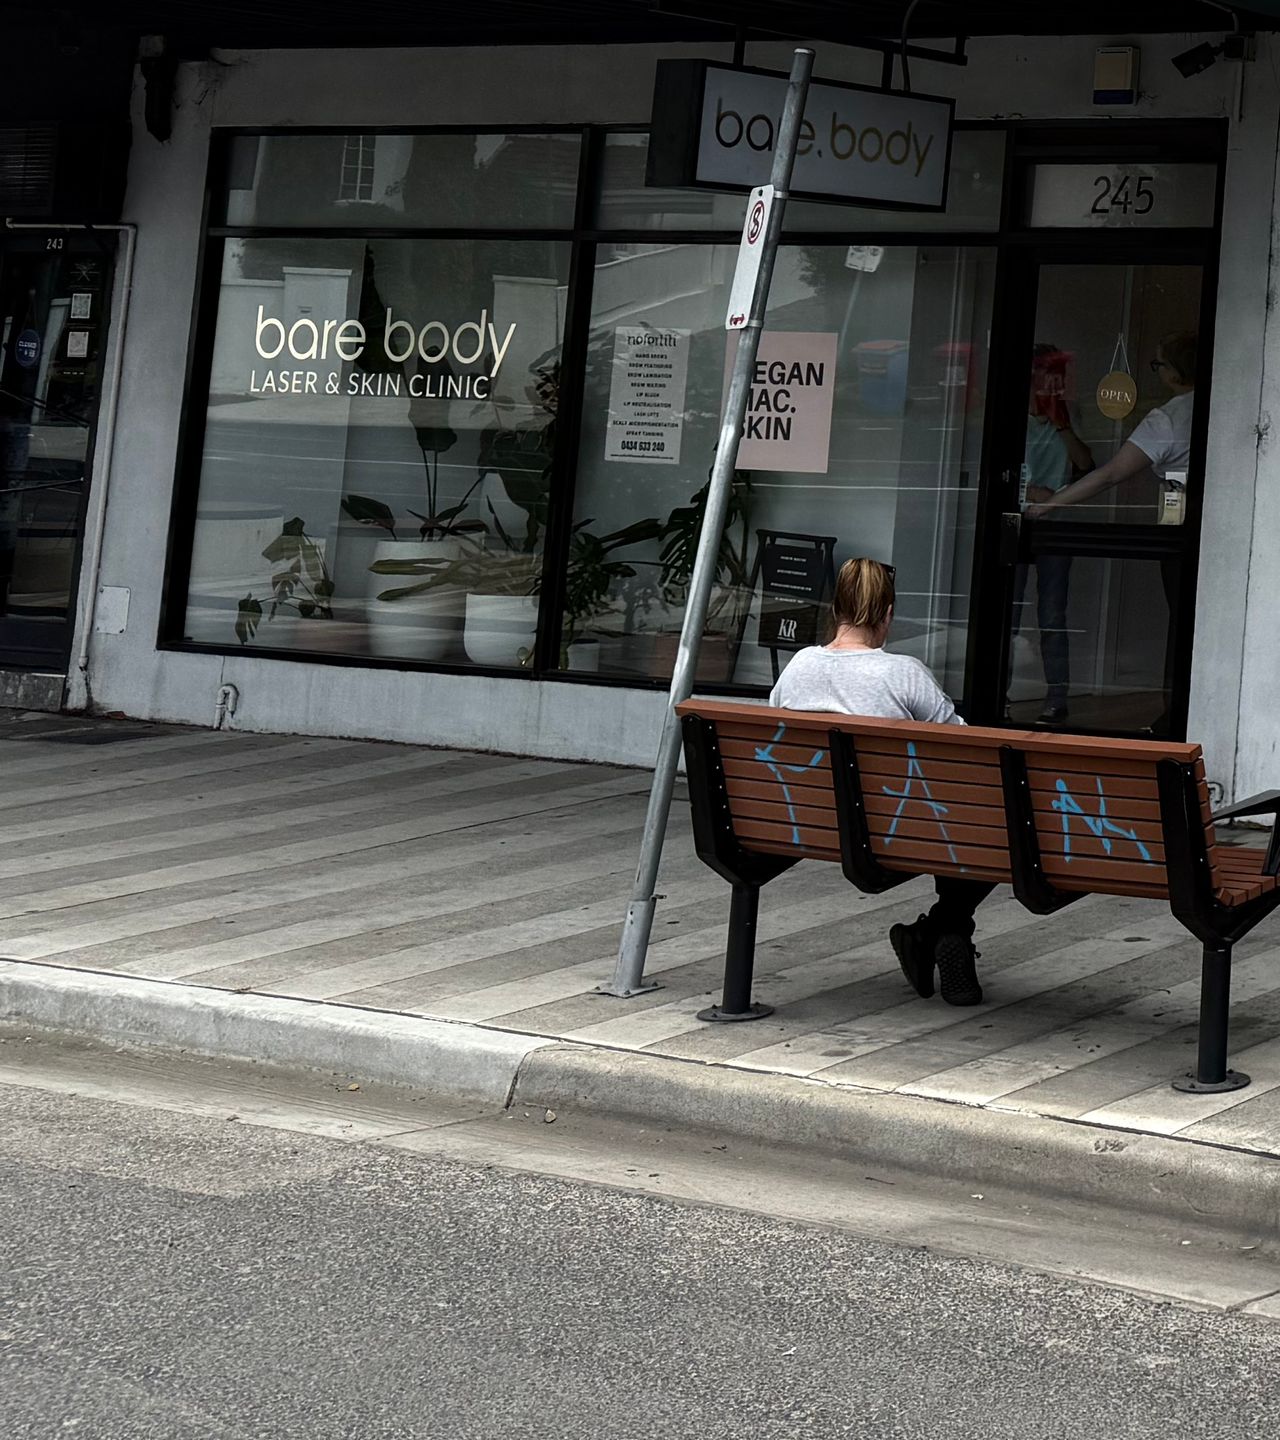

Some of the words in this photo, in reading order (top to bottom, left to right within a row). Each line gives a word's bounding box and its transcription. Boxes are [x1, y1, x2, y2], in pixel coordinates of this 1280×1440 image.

[1091, 175, 1154, 214] 245
[46, 238, 63, 250] 243
[255, 305, 366, 361] bare
[383, 307, 517, 378] body
[250, 369, 317, 394] LASER
[325, 371, 341, 395] &
[347, 373, 401, 396] SKIN
[409, 374, 489, 399] CLINIC
[752, 360, 824, 386] EGAN
[1100, 388, 1132, 403] OPEN
